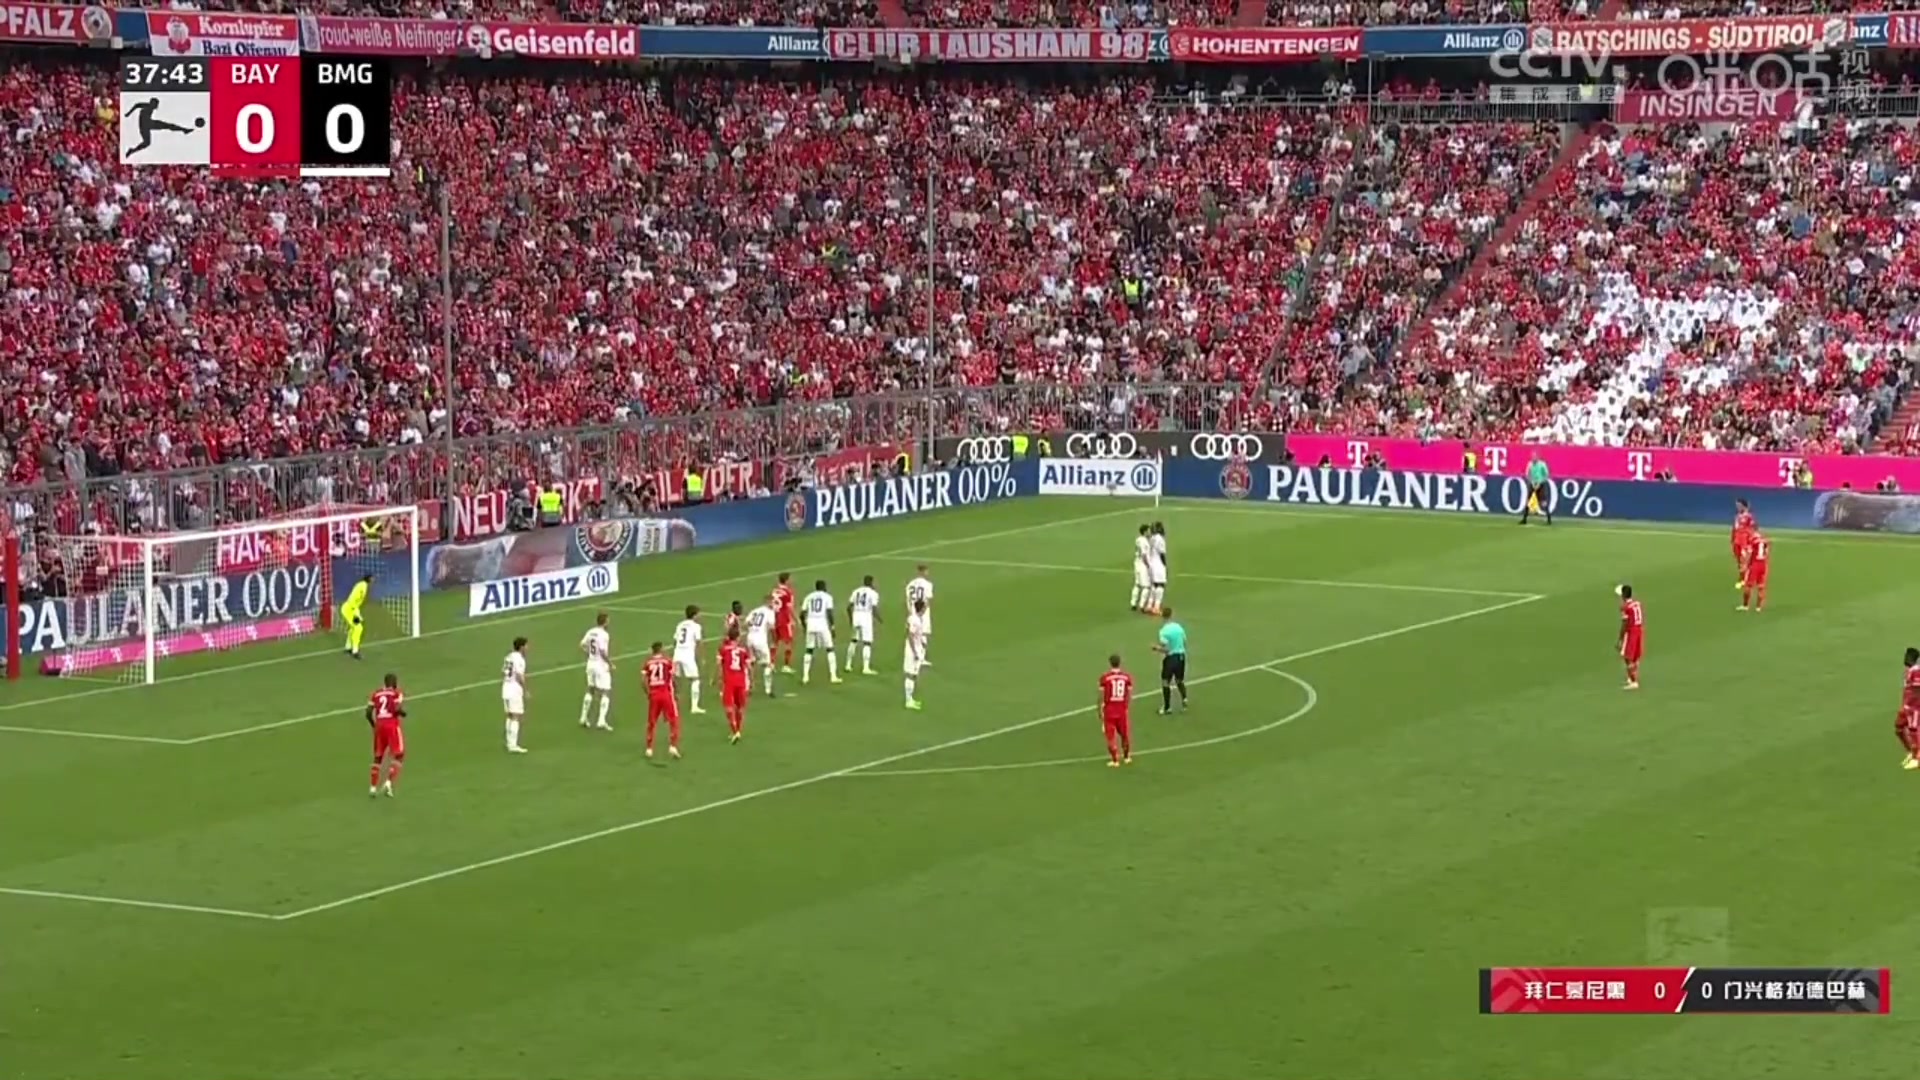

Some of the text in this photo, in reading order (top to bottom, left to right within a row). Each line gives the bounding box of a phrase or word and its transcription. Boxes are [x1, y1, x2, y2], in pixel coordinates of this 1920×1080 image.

[493, 28, 635, 55] Geisenfeld
[767, 35, 819, 51] Allianz
[835, 33, 920, 57] CLUB
[929, 32, 1090, 58] LAUSHAM
[1100, 32, 1145, 58] 98
[1193, 35, 1359, 55] HOHENTENGEN
[1443, 33, 1499, 49] Allianz
[1556, 28, 1691, 51] RATSCHINGS
[1708, 21, 1817, 49] SÜDTIROL
[1640, 92, 1777, 117] INSINGEN
[1042, 464, 1126, 486] Allianz
[1267, 464, 1489, 512] PAULANER
[815, 471, 952, 527] PAULANER
[480, 575, 580, 612] Allianz
[856, 592, 867, 607] 14
[909, 586, 924, 601] 20
[811, 598, 823, 613] 10
[679, 628, 687, 644] 3
[649, 663, 664, 681] 21
[1111, 679, 1125, 697] 18
[379, 695, 387, 714] 2
